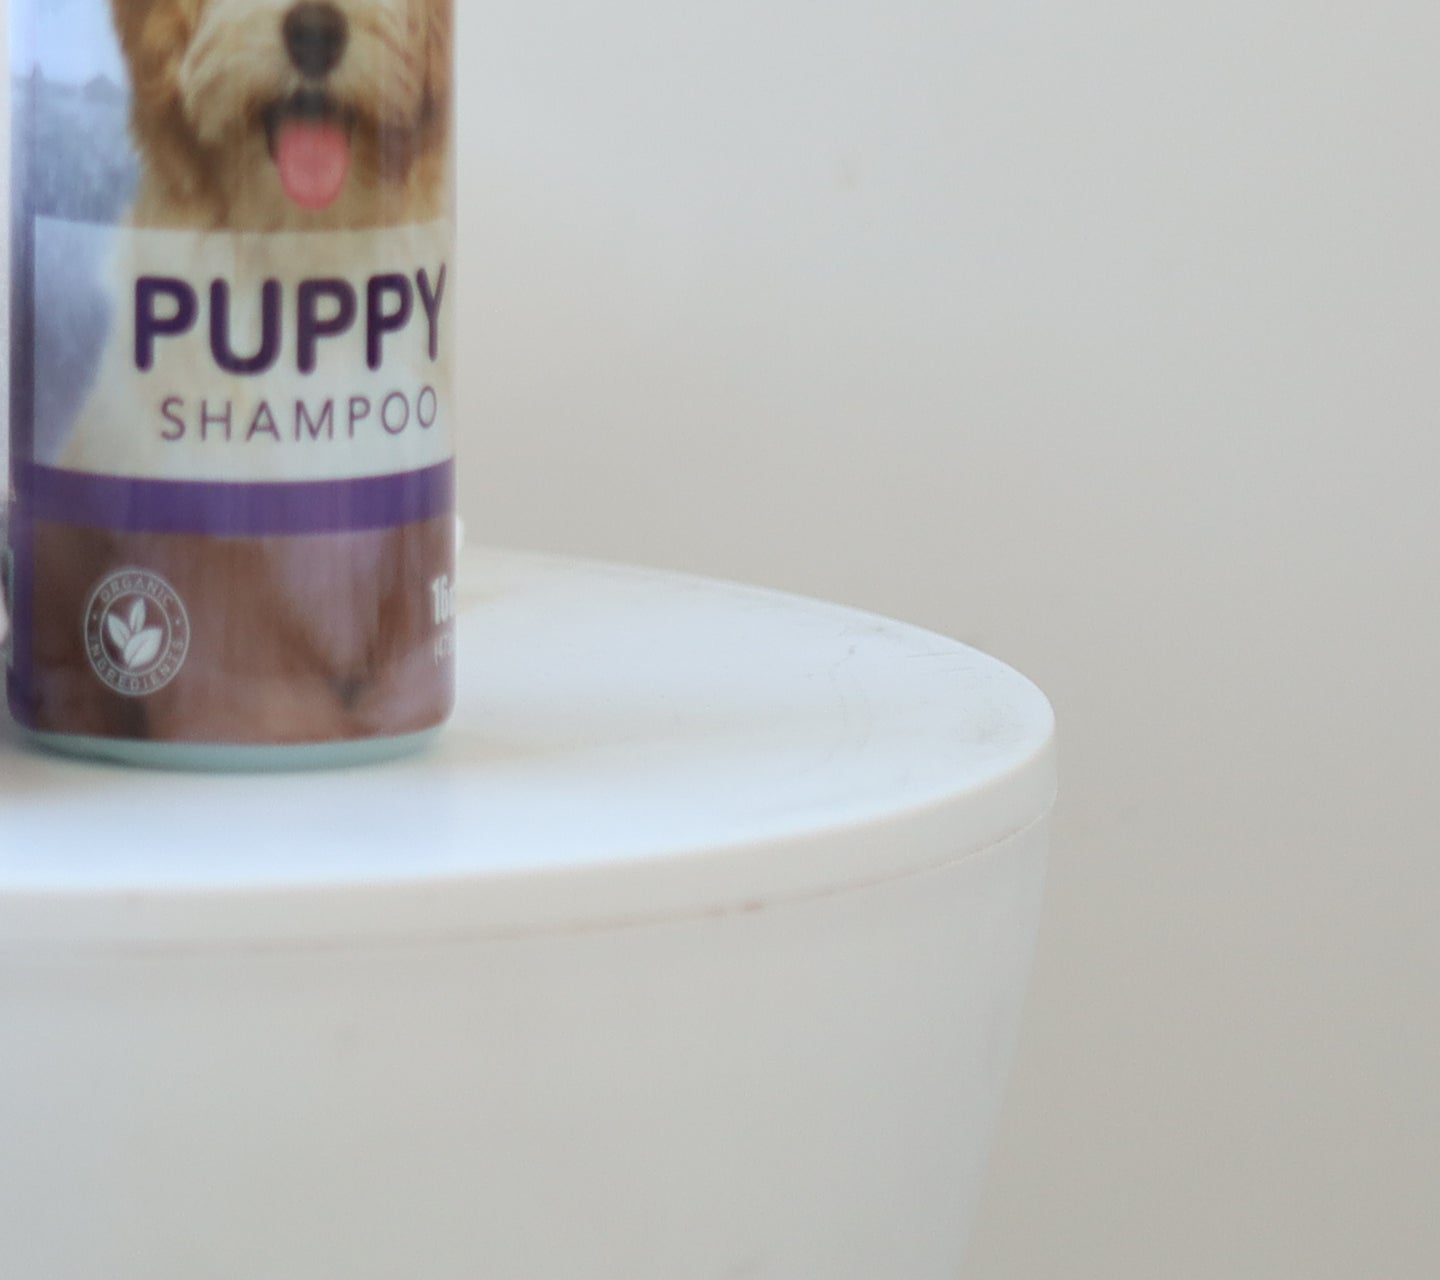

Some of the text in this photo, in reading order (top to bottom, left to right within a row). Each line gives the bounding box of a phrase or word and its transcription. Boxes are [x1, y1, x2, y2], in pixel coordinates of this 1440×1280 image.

[134, 262, 446, 376] PUPPY
[160, 386, 437, 442] SHAMPOO
[100, 576, 174, 606] ORGANIC
[89, 635, 185, 692] INGREDIENTS
